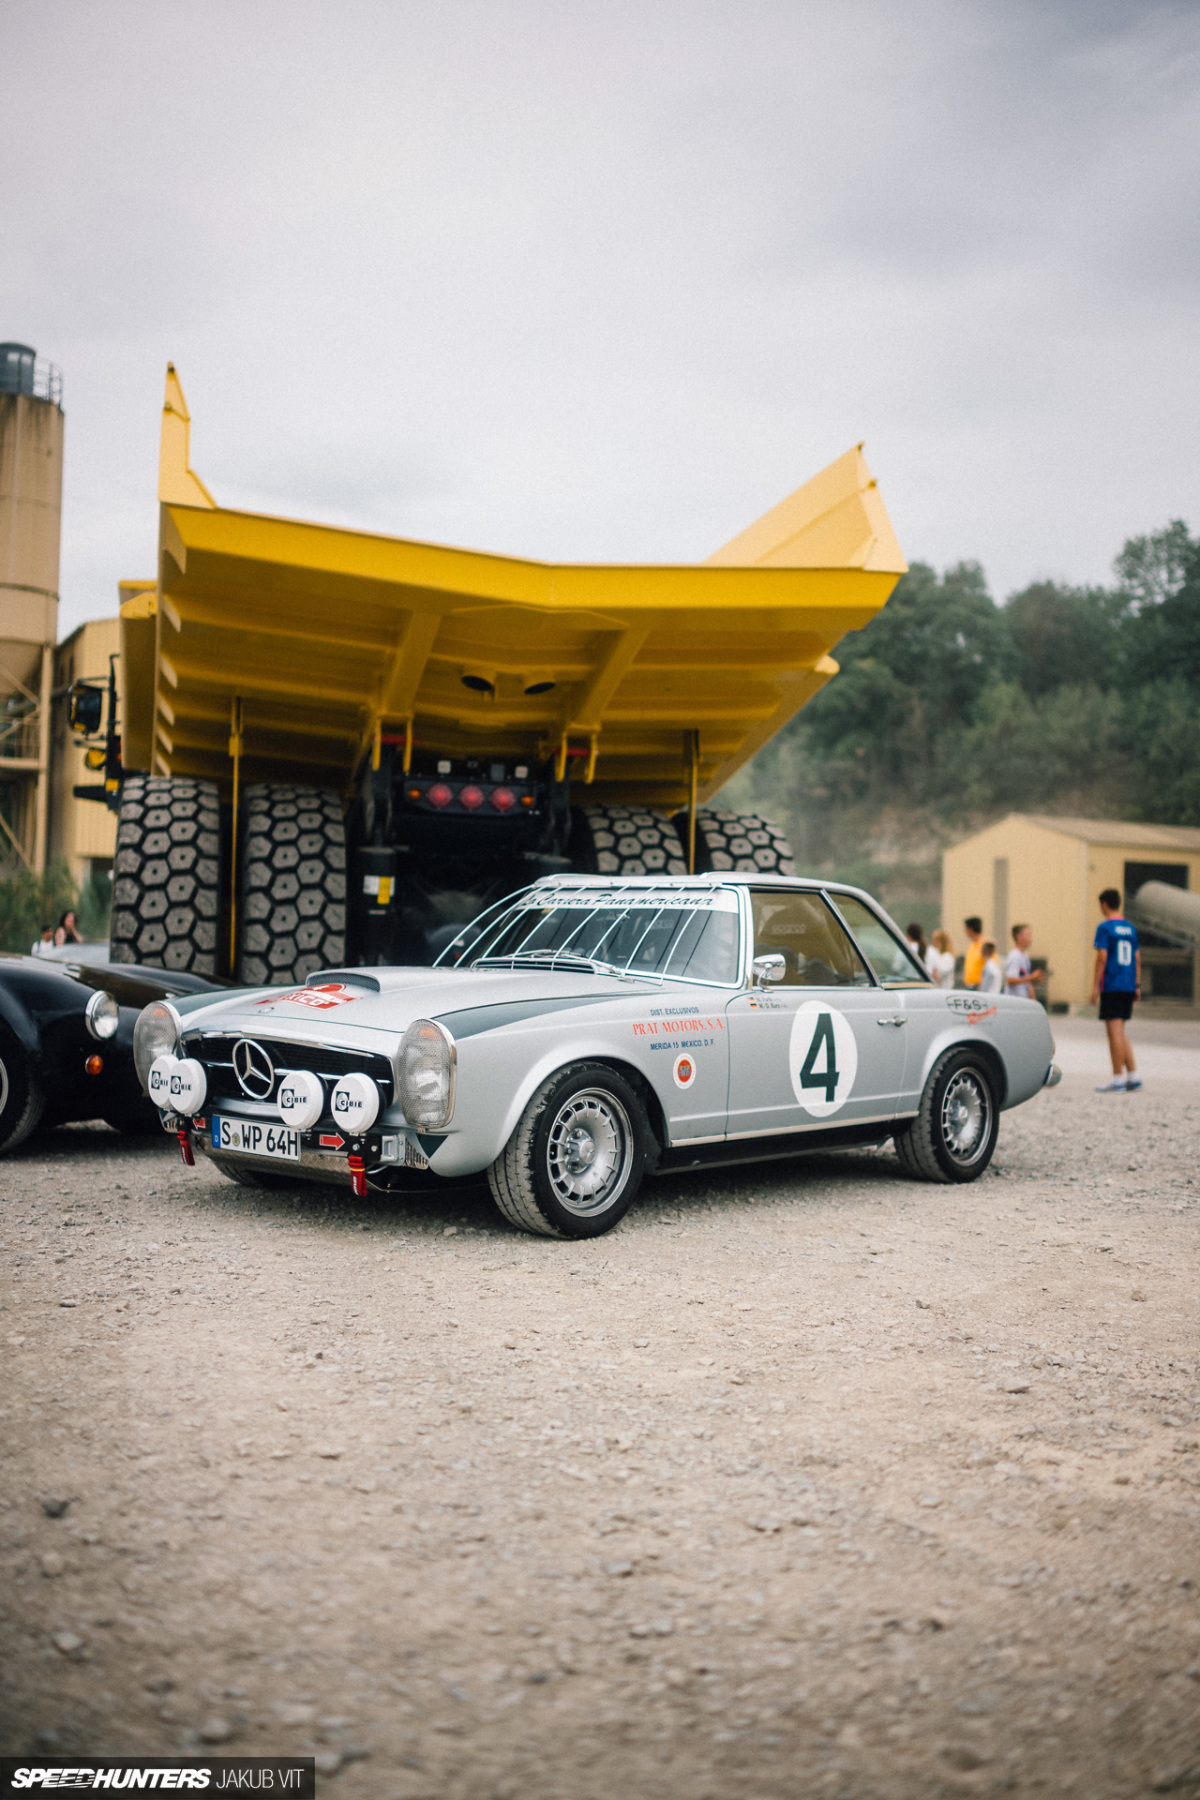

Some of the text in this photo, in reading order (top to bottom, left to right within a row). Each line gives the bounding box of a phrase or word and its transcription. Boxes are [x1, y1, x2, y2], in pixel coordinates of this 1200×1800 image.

[665, 1006, 700, 1015] EXCLUSIVOS
[953, 999, 982, 1011] F&S
[632, 1022, 659, 1036] PRAT
[650, 1042, 672, 1051] MERIDA
[800, 1013, 840, 1102] 4
[221, 1121, 232, 1146] S
[241, 1123, 263, 1151] WP
[266, 1128, 298, 1157] 64H
